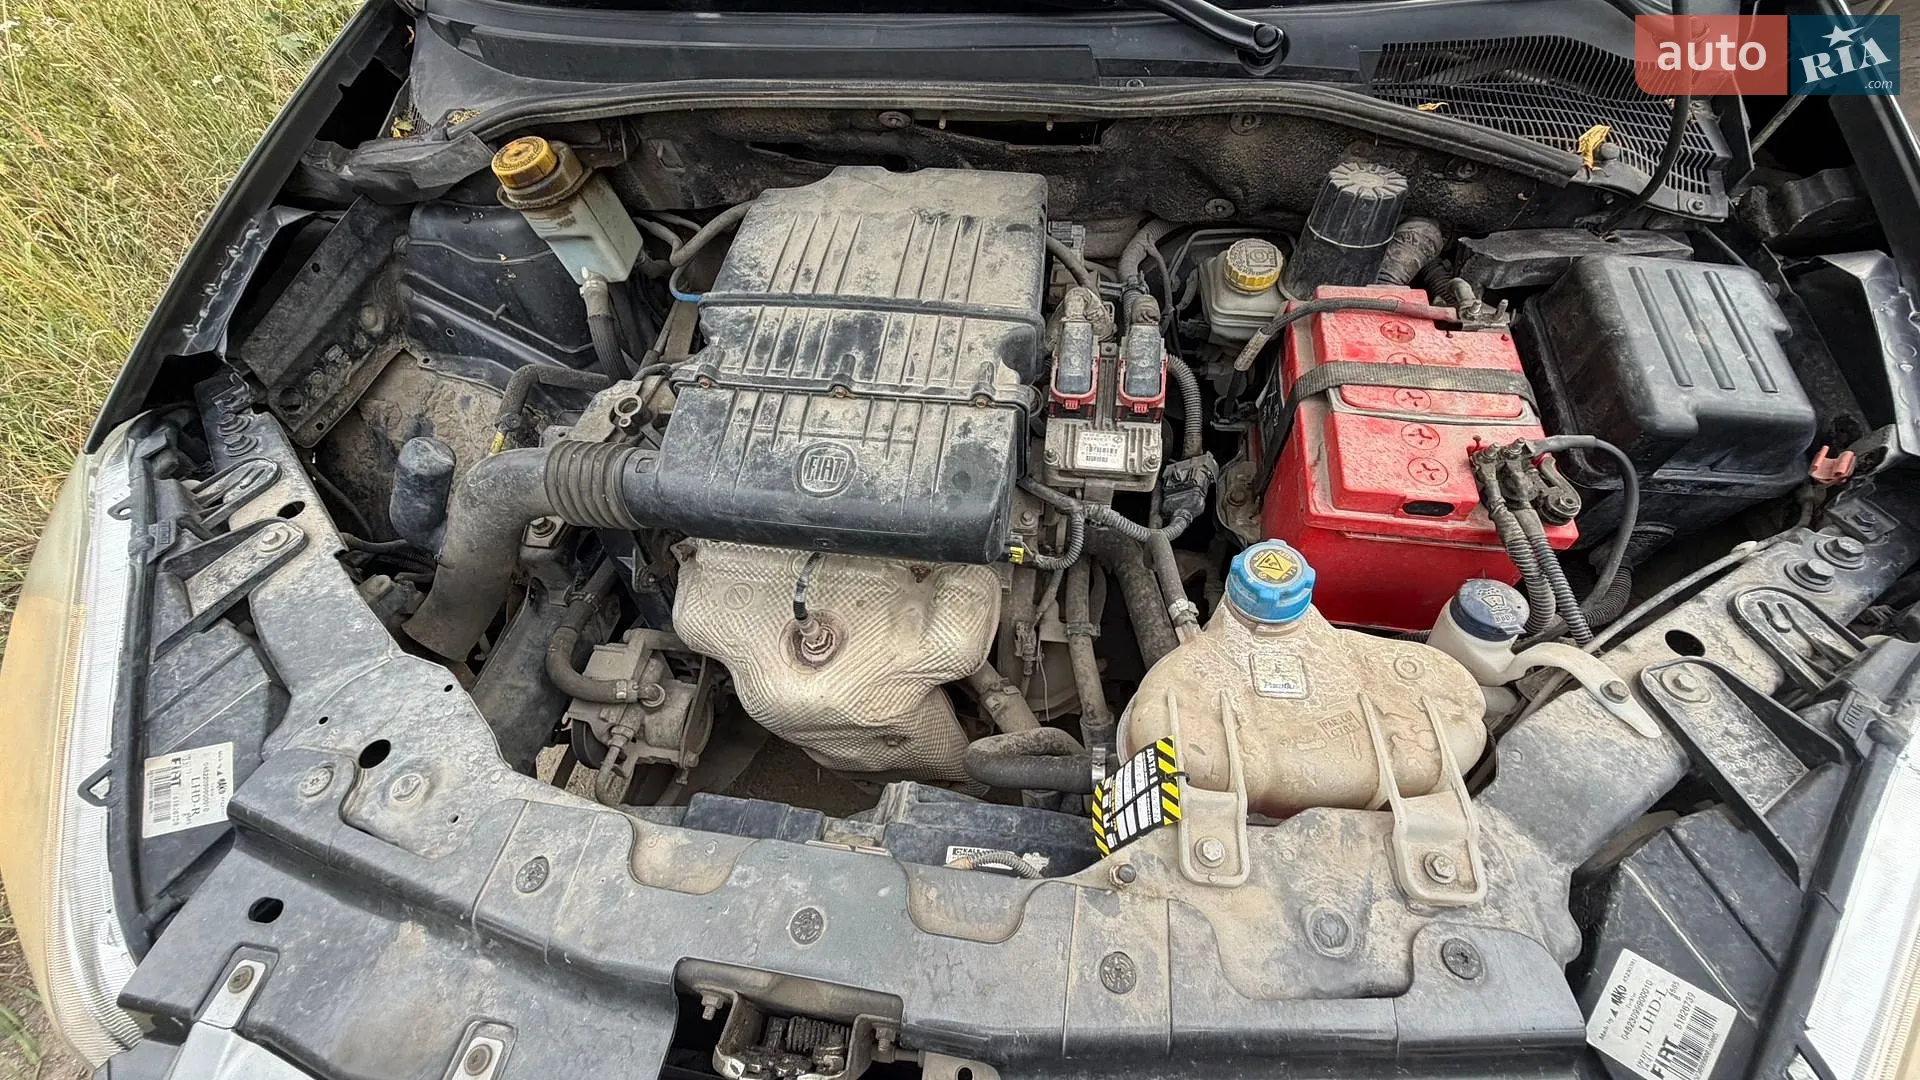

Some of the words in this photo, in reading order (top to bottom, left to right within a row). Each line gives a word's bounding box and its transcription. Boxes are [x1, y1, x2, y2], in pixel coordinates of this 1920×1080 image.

[806, 455, 846, 483] FIAT
[171, 757, 182, 787] FIAT
[191, 776, 201, 816] LHD-R
[1639, 988, 1668, 1035] LHD-L
[1650, 1034, 1680, 1080] FIAT
